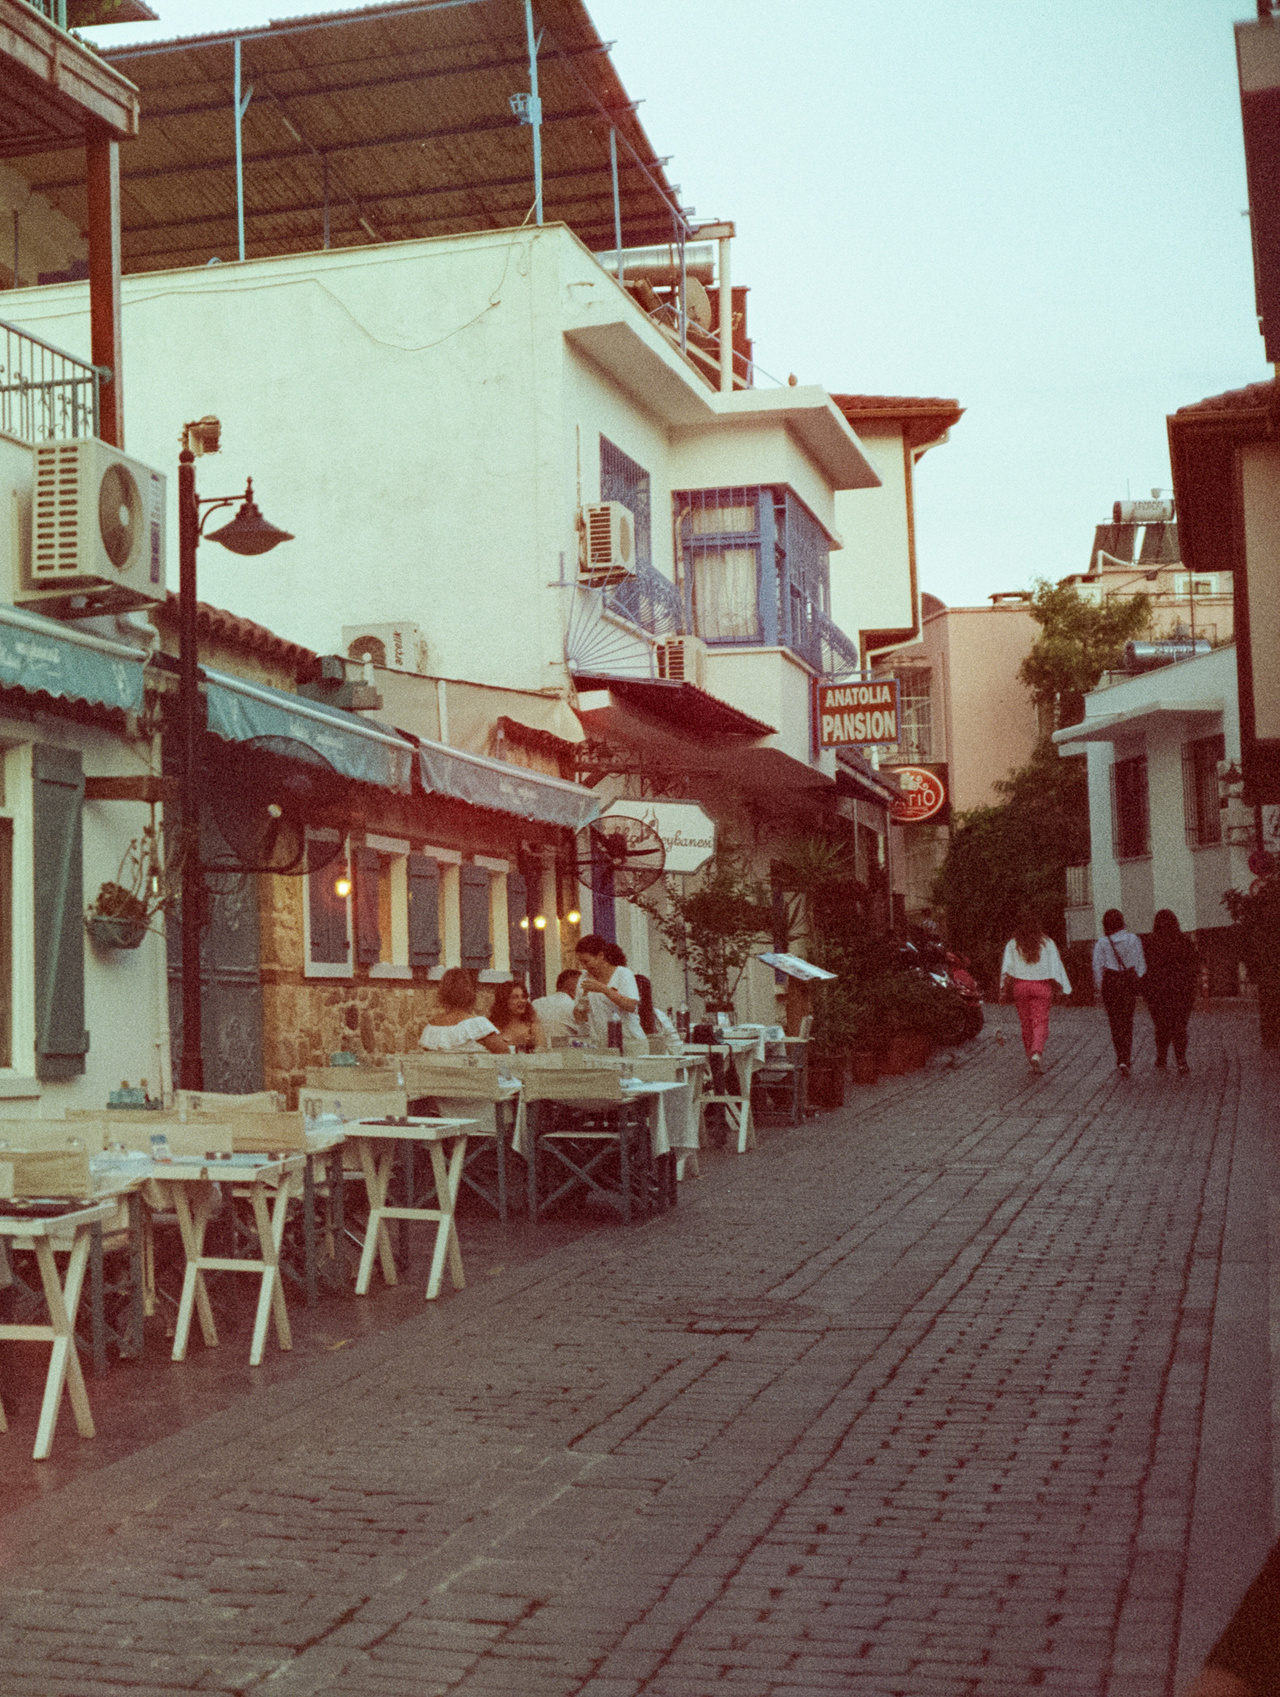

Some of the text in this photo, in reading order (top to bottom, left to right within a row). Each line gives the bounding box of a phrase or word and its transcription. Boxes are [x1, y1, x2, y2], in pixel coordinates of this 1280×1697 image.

[825, 685, 892, 708] ANATOLIA
[822, 710, 897, 743] PANSION
[658, 829, 714, 852] eyhanesi
